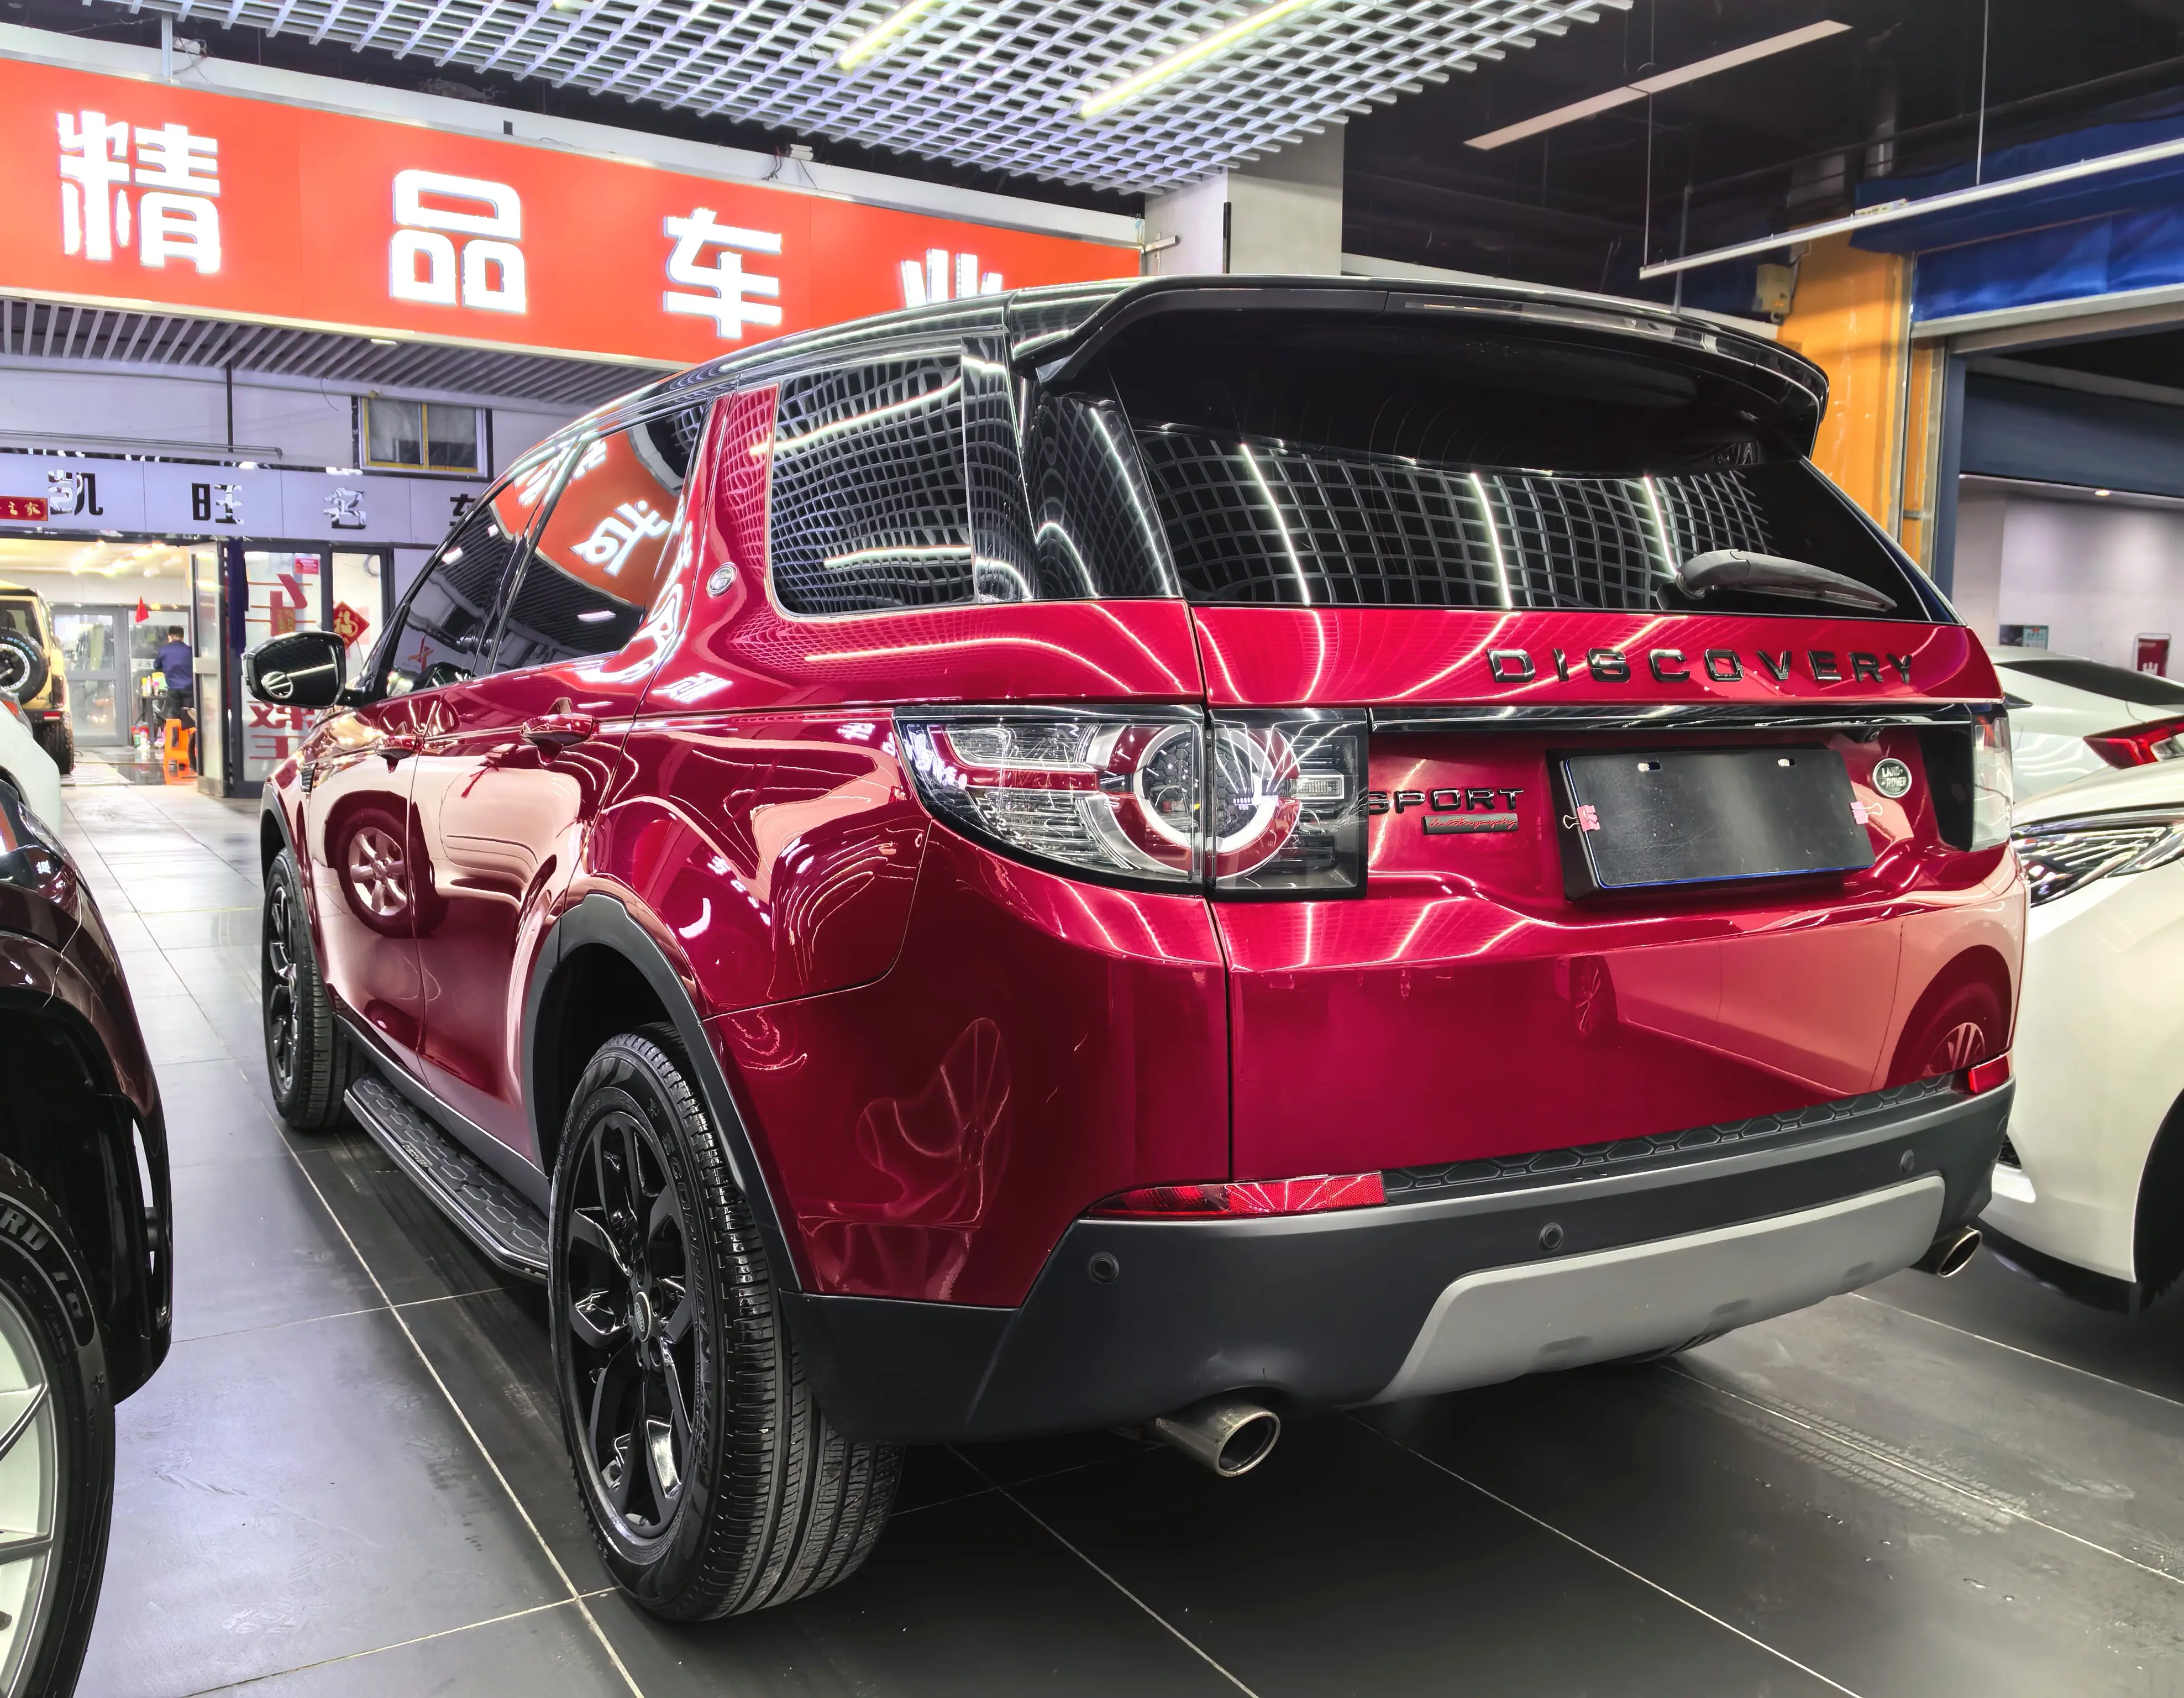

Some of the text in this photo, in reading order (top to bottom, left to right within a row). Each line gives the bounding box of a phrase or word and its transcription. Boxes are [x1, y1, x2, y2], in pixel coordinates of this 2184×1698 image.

[1485, 647, 1914, 685] DISCOVERY
[1881, 766, 1900, 778] LAND
[1886, 776, 1907, 788] ROVER
[1367, 787, 1524, 816] SPORT
[0, 1204, 49, 1251] RD
